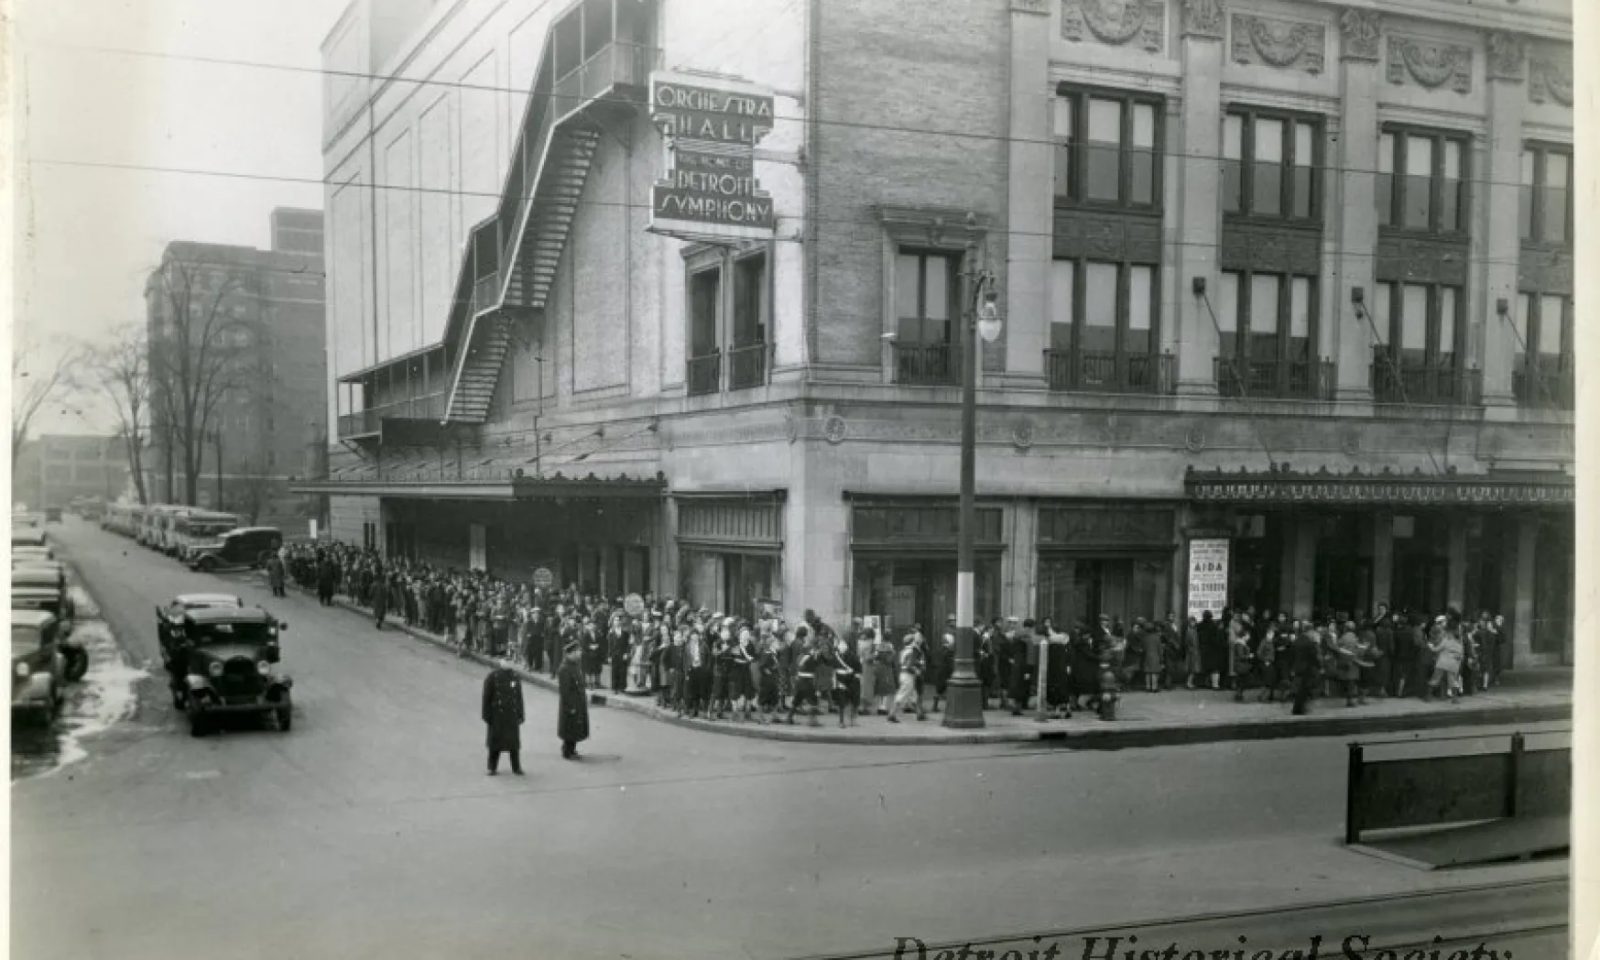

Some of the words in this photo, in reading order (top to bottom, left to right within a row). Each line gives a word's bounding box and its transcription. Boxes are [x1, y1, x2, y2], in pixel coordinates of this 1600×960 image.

[657, 86, 771, 116] ORCHESTRA
[680, 113, 754, 141] HALL
[678, 170, 753, 196] DETROIT
[656, 193, 769, 221] SYMPHONY
[1195, 562, 1222, 571] AIDA
